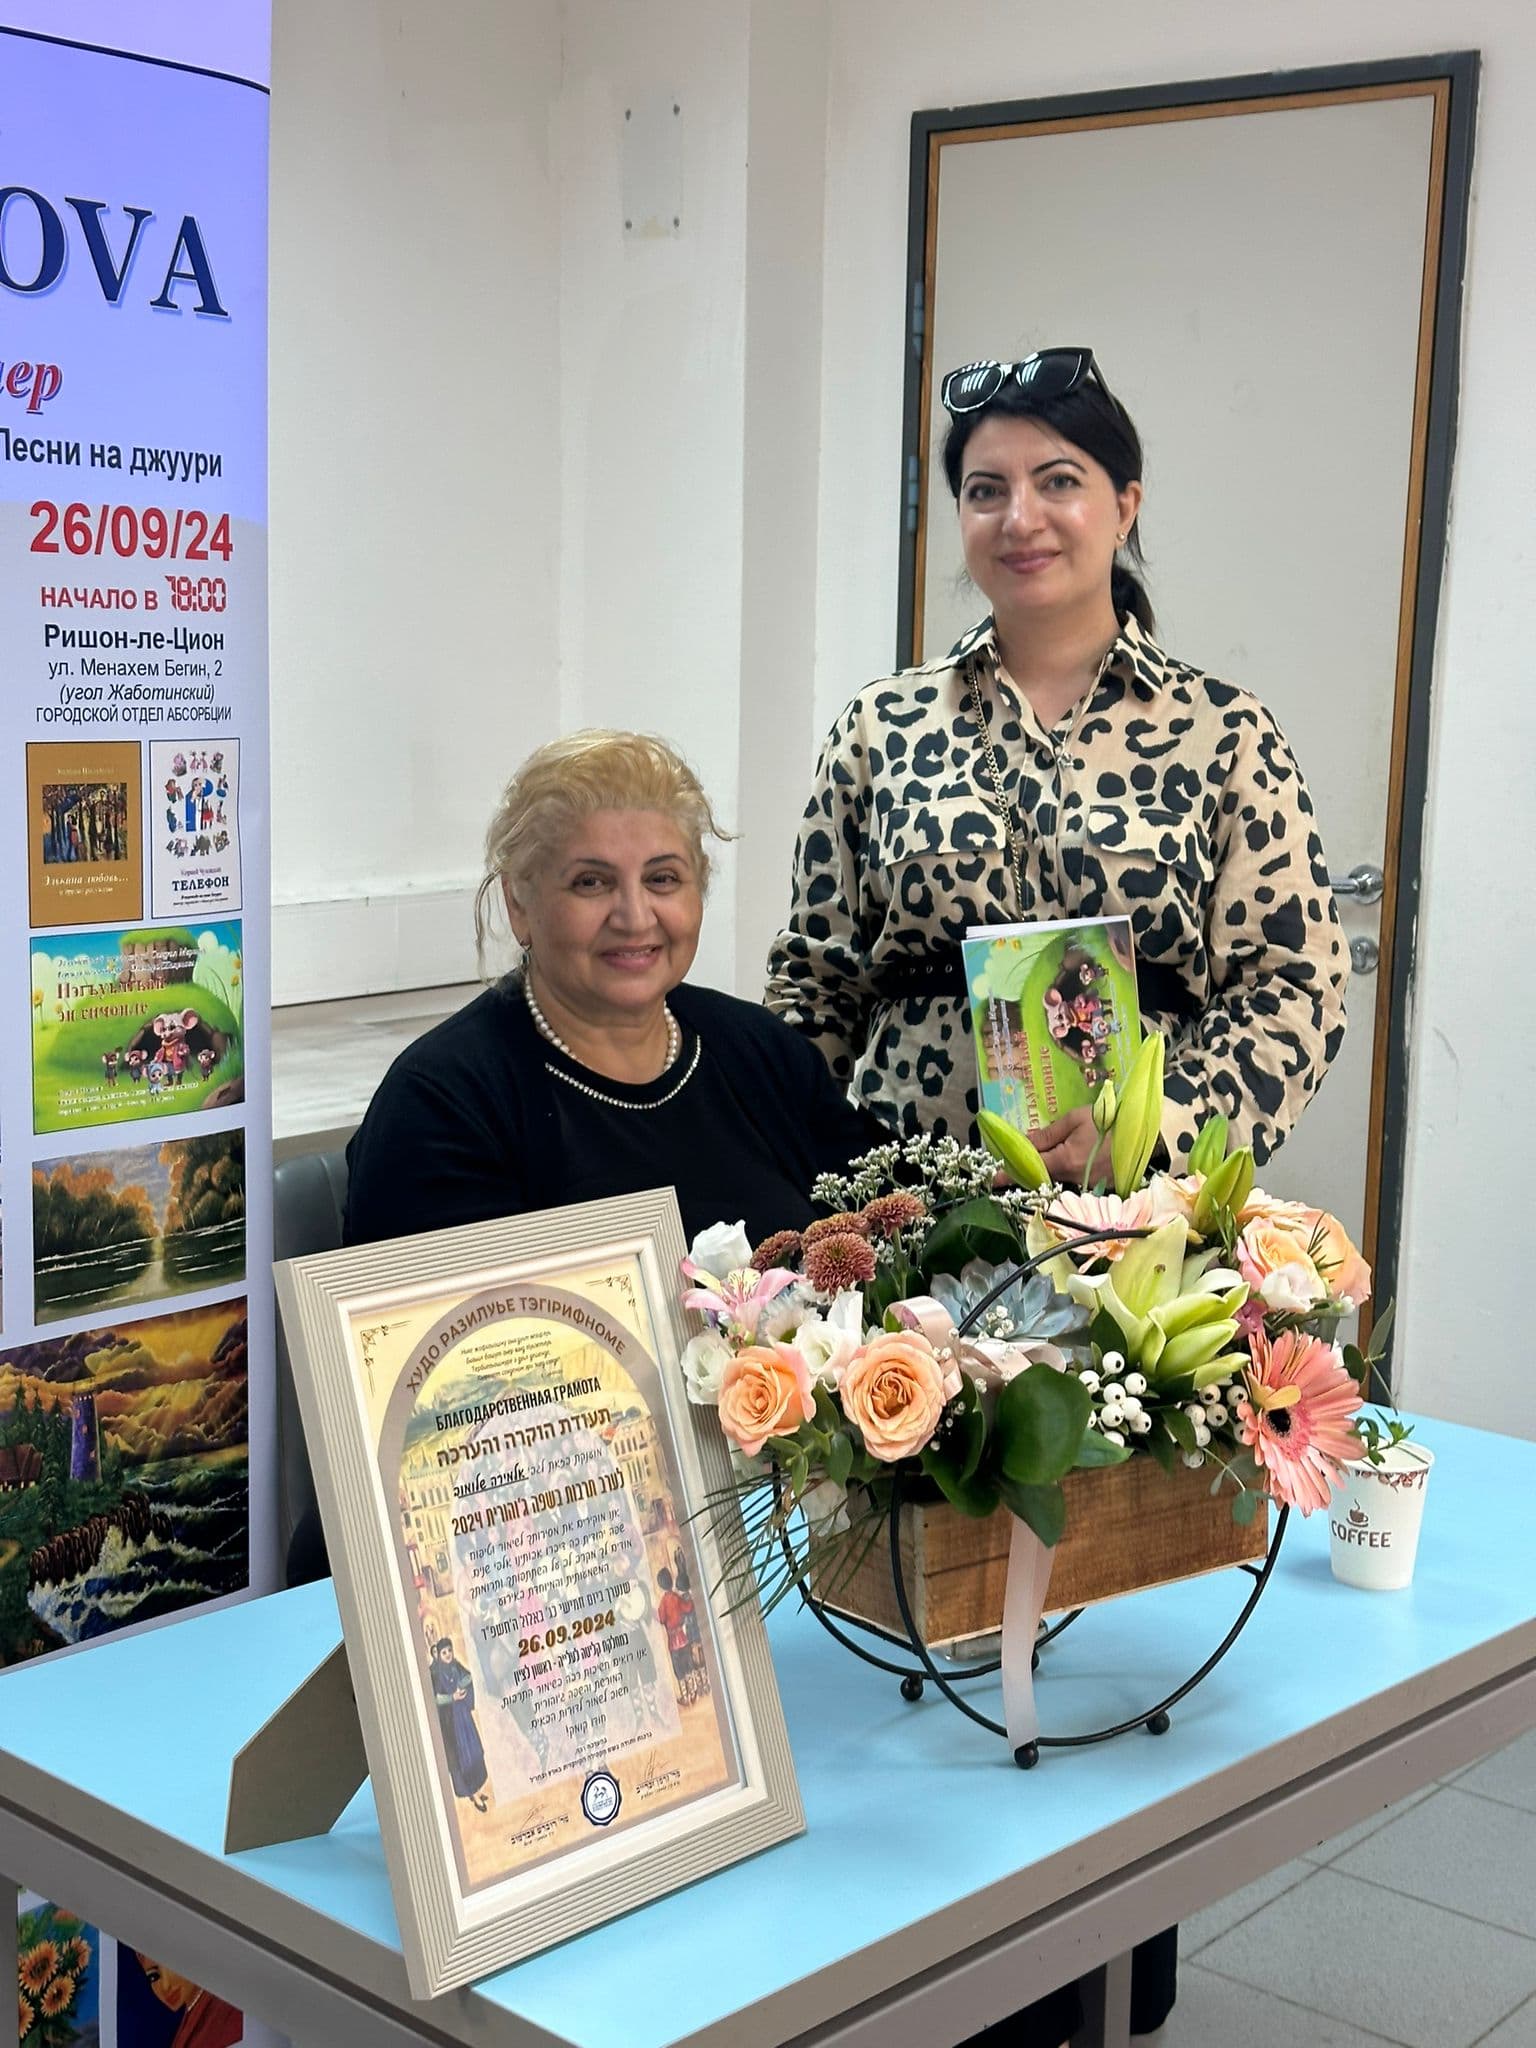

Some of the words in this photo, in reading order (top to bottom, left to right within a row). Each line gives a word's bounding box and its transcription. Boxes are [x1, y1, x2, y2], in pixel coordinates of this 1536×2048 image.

[0, 187, 230, 318] OVA
[0, 361, 62, 415] ер
[90, 443, 122, 469] на
[129, 446, 222, 483] джуури
[30, 500, 234, 561] 26/09/24
[41, 586, 137, 610] НАЧАЛО
[144, 590, 158, 610] В
[165, 575, 227, 612] 18:00
[45, 623, 225, 653] Ришон-ле-Цион
[48, 660, 74, 679] ул.
[80, 658, 159, 677] Менахем
[164, 660, 210, 679] Бегин,
[214, 659, 223, 677] 2
[60, 684, 103, 705] (угол
[108, 682, 215, 702] Жаботинский)
[36, 703, 118, 726] ГОРОДСКОЙ
[122, 707, 163, 724] ОТДЕЛ
[167, 705, 232, 724] АБСОРБЦИИ
[172, 876, 229, 891] ТЕЛЕФОН
[406, 1347, 442, 1395] ХУДО
[435, 1389, 552, 1432] БЛАГОДАРСТВЕННАЯ
[553, 1376, 601, 1401] ГРАМОТА
[558, 1407, 611, 1436] תעודת
[503, 1422, 556, 1451] הוקרה
[436, 1437, 500, 1467] והערכה
[563, 1477, 597, 1504] תרבות
[597, 1466, 625, 1493] לערב
[530, 1487, 563, 1513] בשפה
[451, 1511, 483, 1536] 2024
[1331, 1520, 1392, 1548] COFFEE
[586, 1590, 604, 1606] ביום
[605, 1580, 631, 1602] שנערך
[559, 1596, 585, 1615] חמישי
[515, 1608, 617, 1658] 26.09.2024
